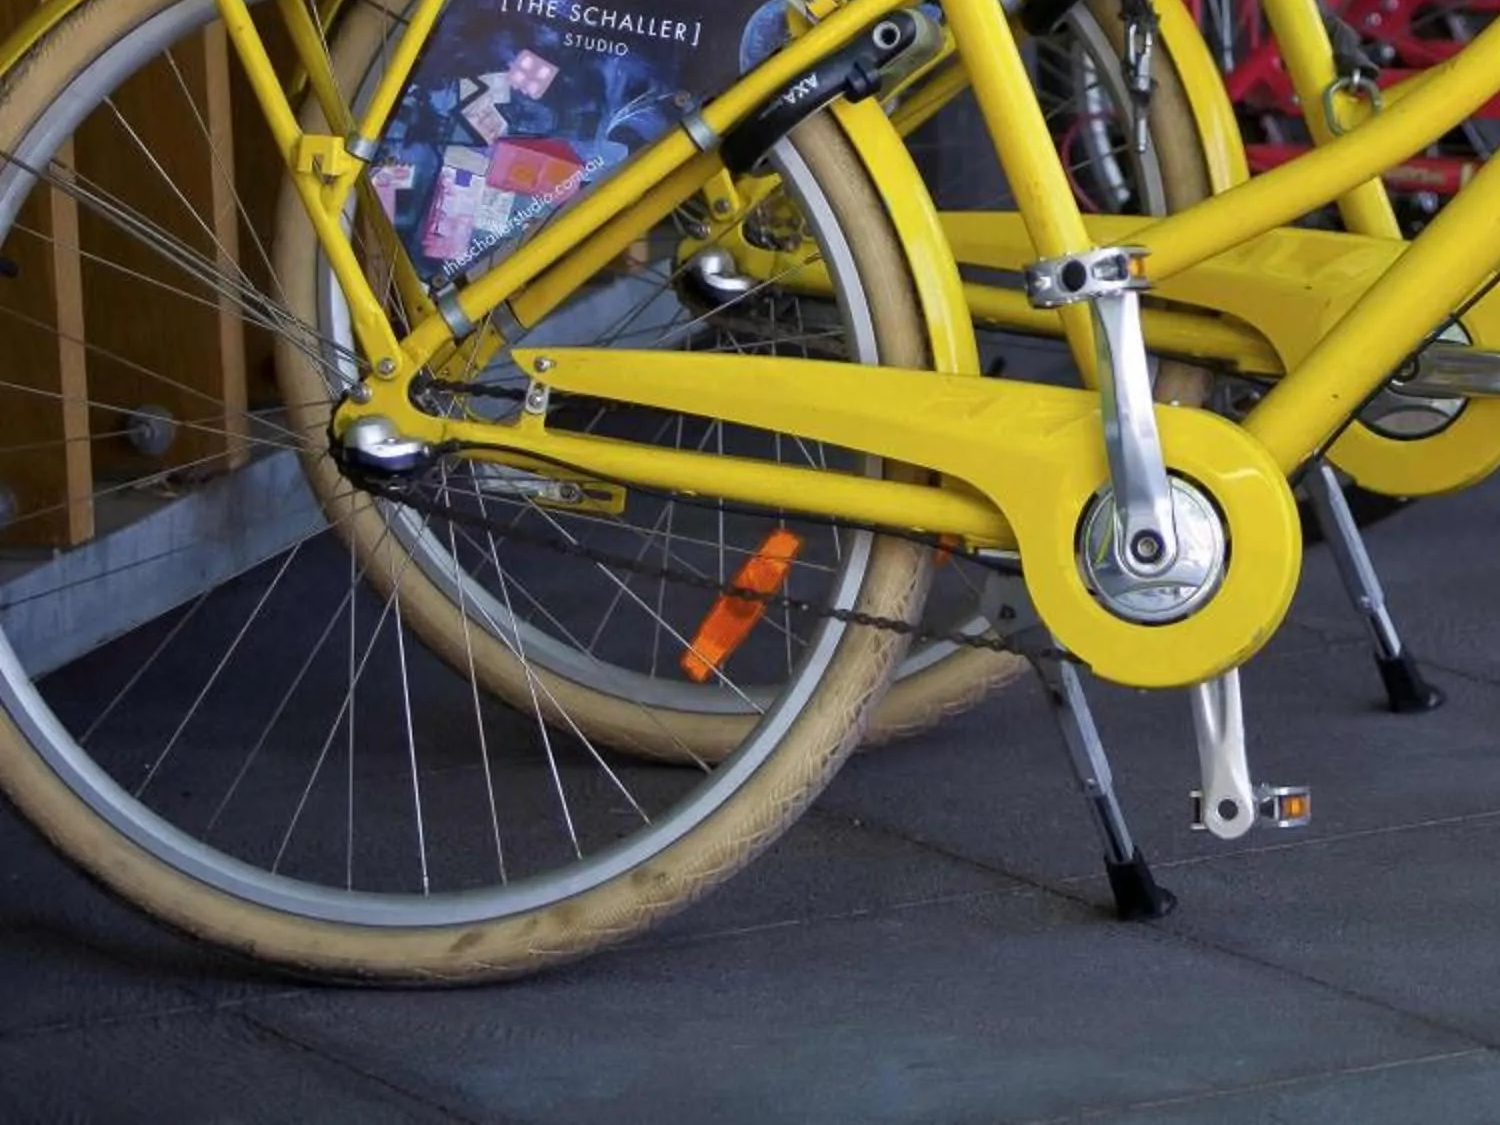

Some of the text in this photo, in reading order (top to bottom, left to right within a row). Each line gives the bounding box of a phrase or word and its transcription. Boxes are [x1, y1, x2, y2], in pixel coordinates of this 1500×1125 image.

[568, 4, 701, 47] SCHALLER]
[563, 32, 629, 57] STUDIO
[783, 72, 818, 104] AXA
[443, 154, 605, 277] theschallerstudio.com.au
